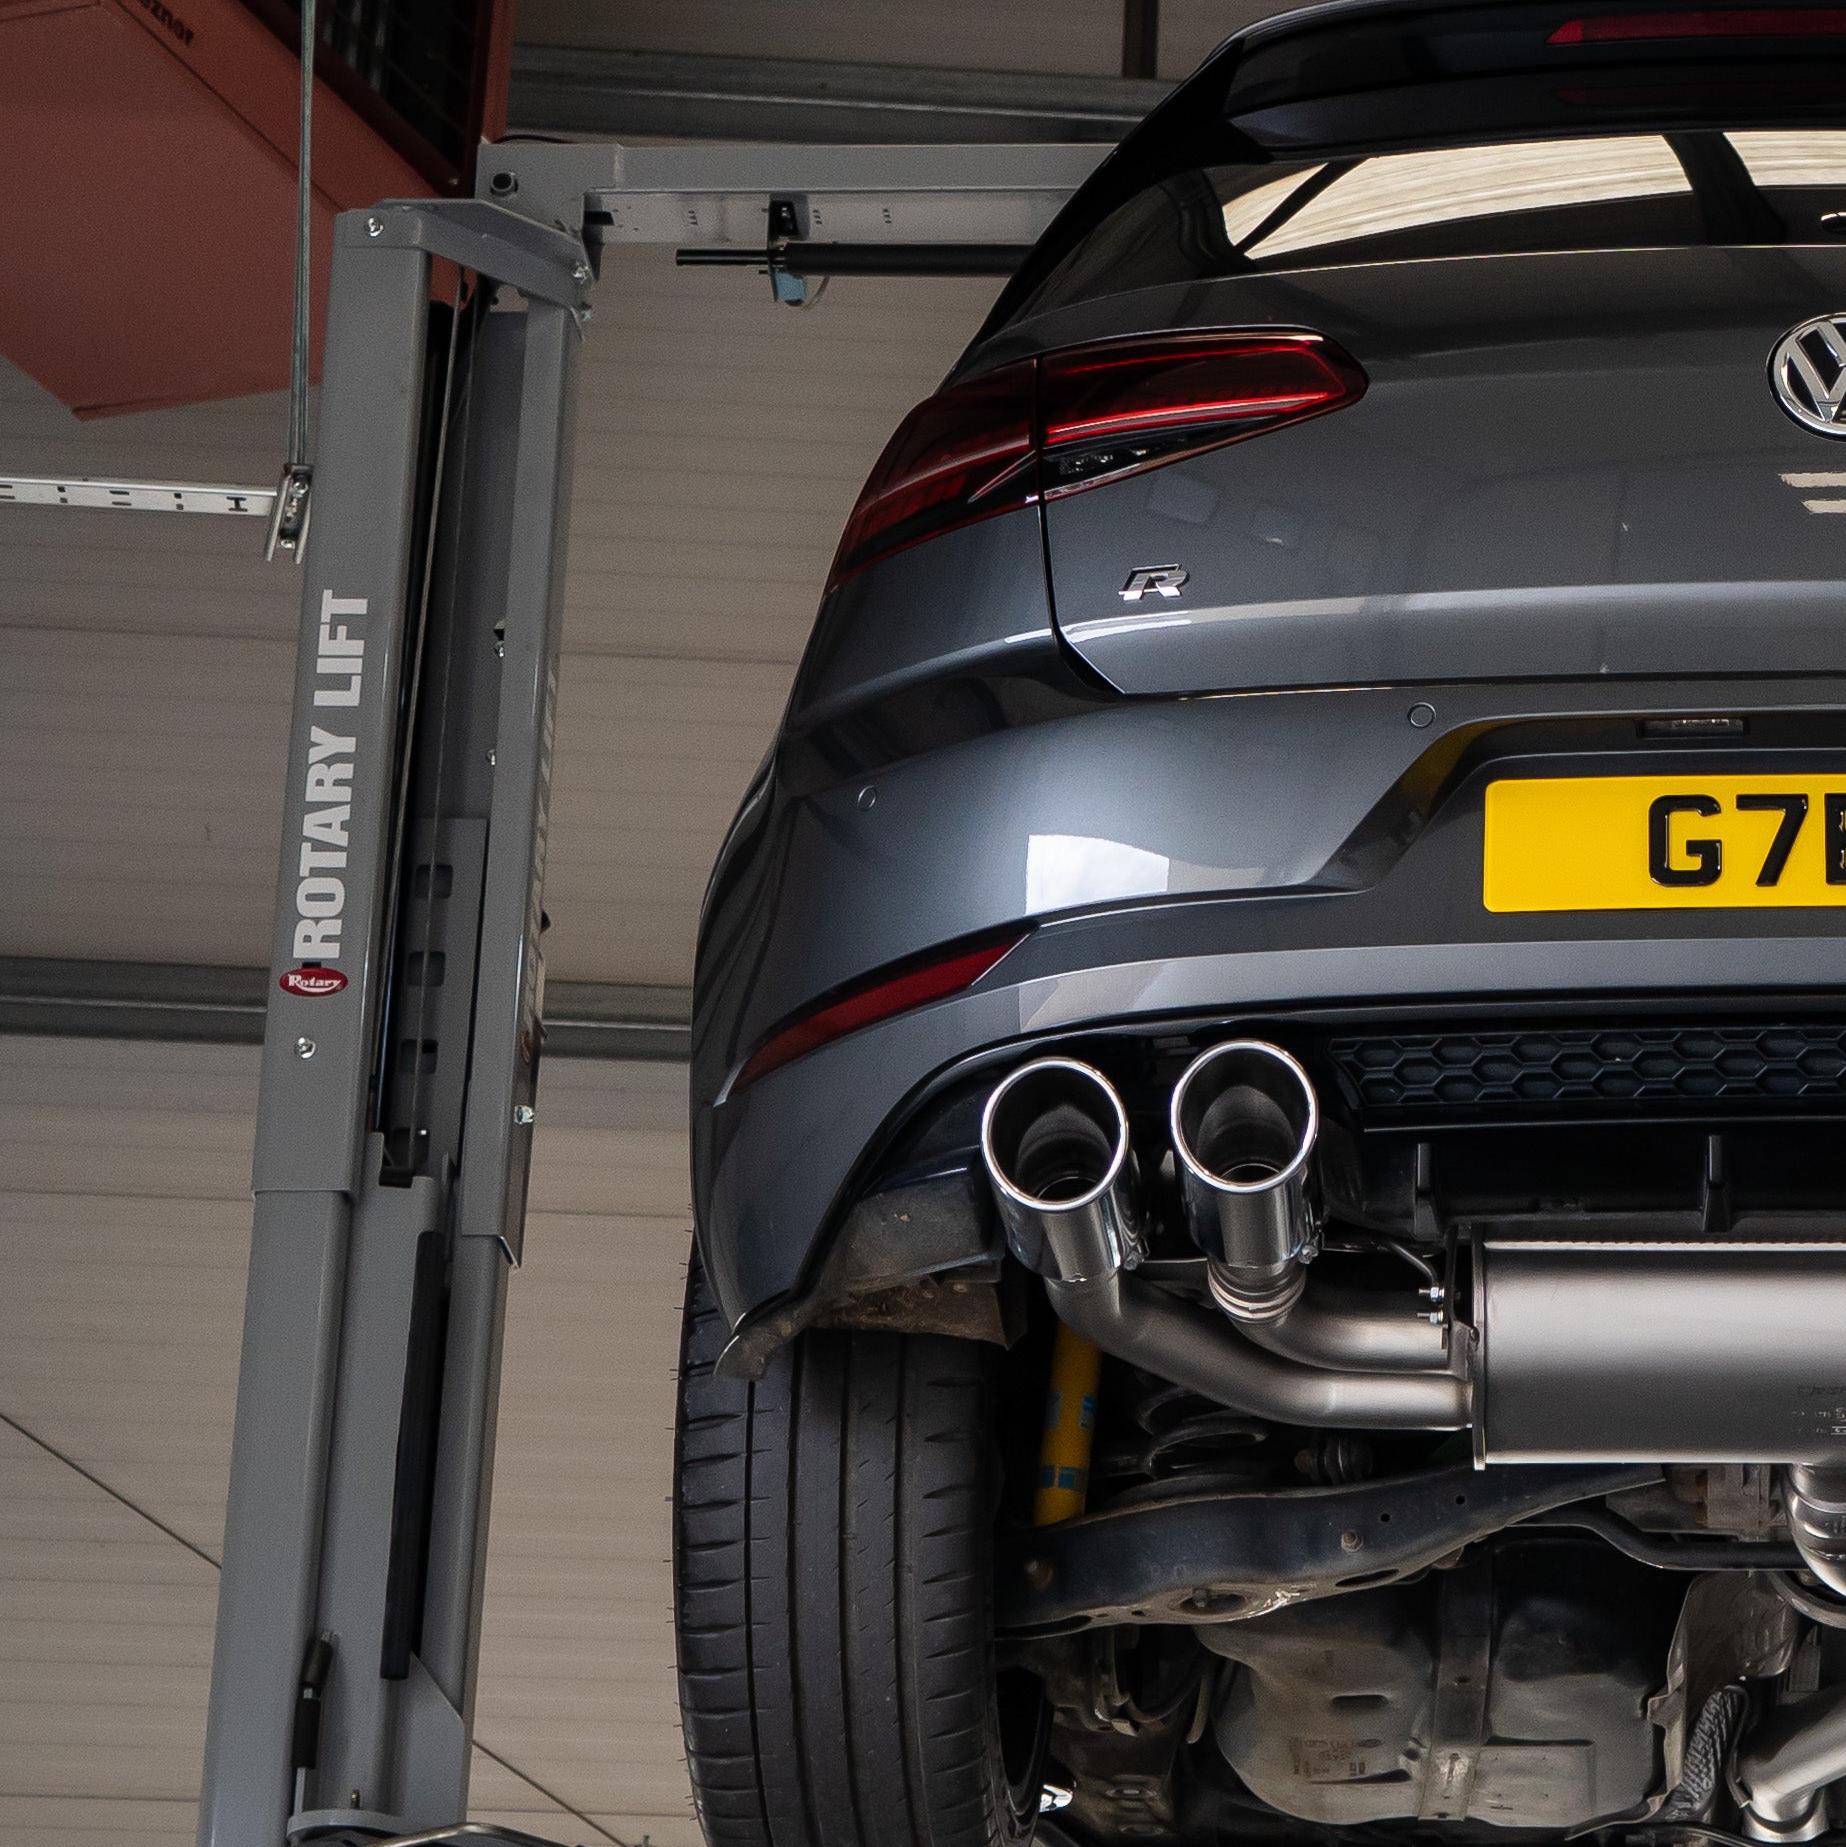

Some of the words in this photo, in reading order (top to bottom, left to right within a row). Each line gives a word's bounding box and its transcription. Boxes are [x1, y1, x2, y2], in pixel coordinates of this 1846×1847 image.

[1118, 563, 1190, 601] R
[313, 589, 368, 707] LIFT
[293, 725, 356, 959] ROTARY
[288, 974, 341, 992] Rotary
